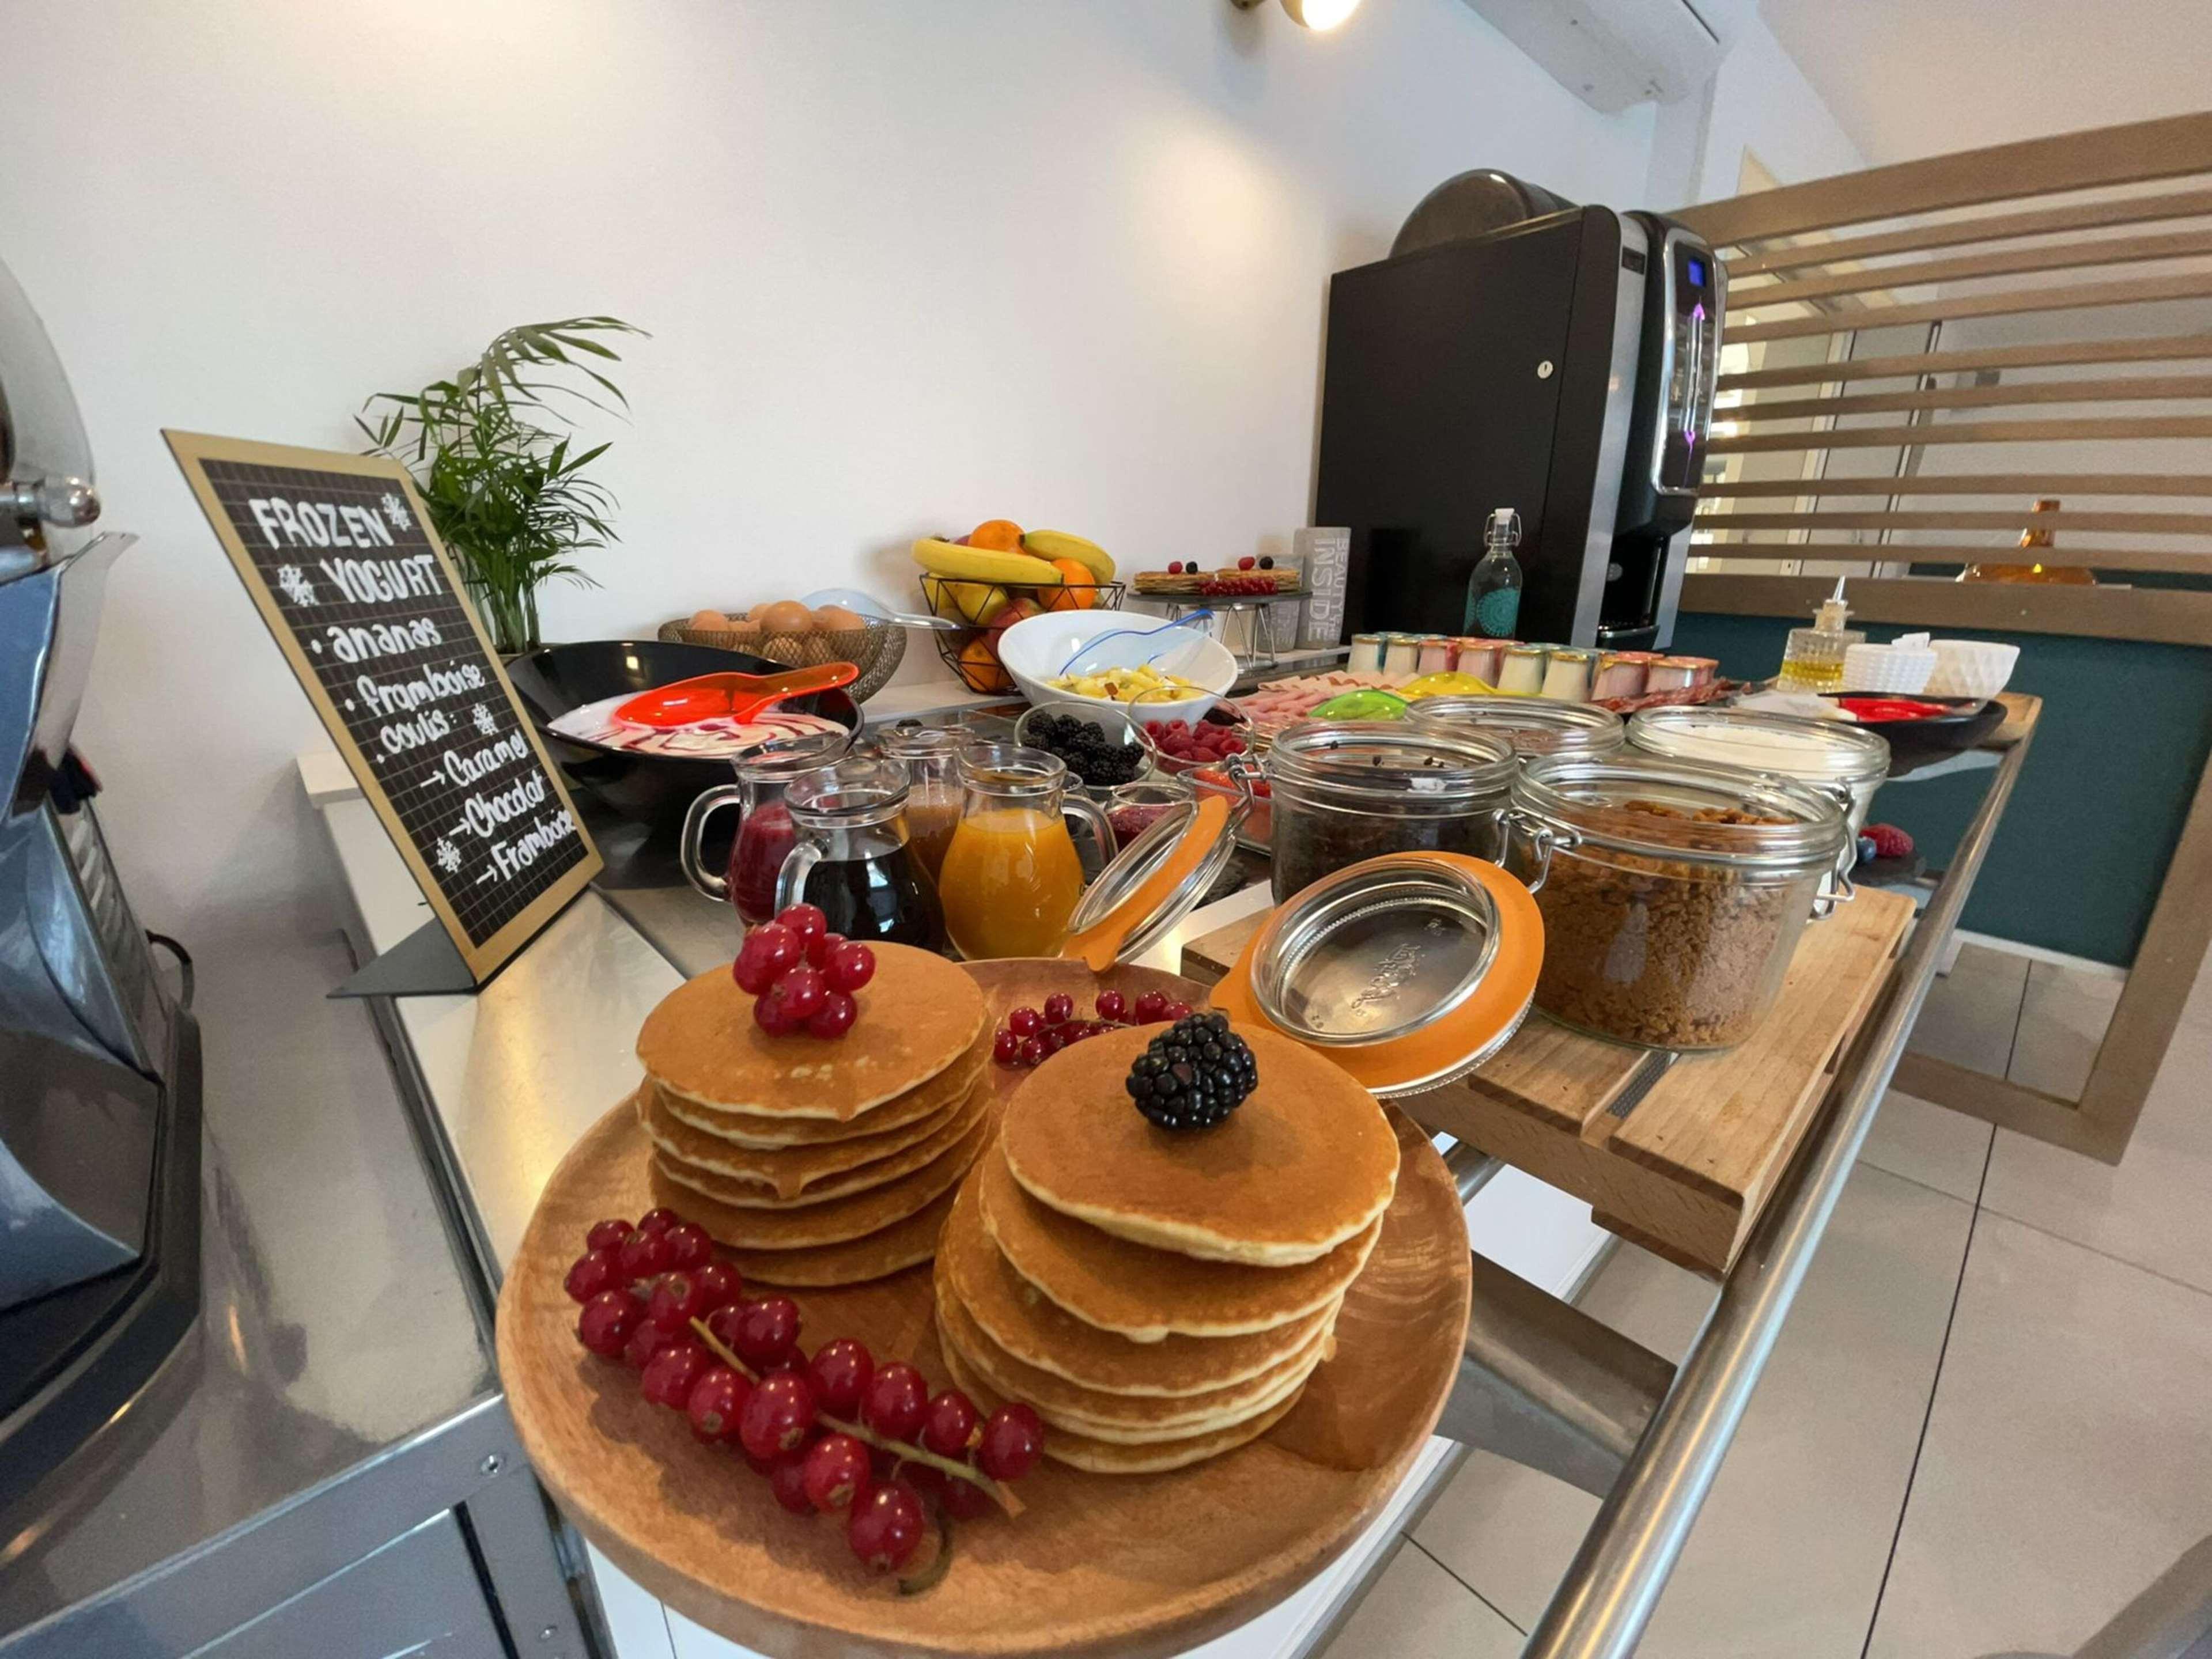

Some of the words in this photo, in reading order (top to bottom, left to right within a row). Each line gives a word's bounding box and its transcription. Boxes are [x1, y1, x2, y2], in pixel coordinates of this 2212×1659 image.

[248, 498, 394, 550] FROZEN
[320, 555, 442, 603] YOGURT
[1307, 537, 1336, 642] INSIDE
[1330, 537, 1349, 613] BEAUTY
[327, 618, 442, 662] ananas
[357, 660, 486, 717] framboise
[444, 728, 528, 787] Caramel
[465, 769, 545, 838] Chocolat
[491, 808, 577, 881] Framboise
